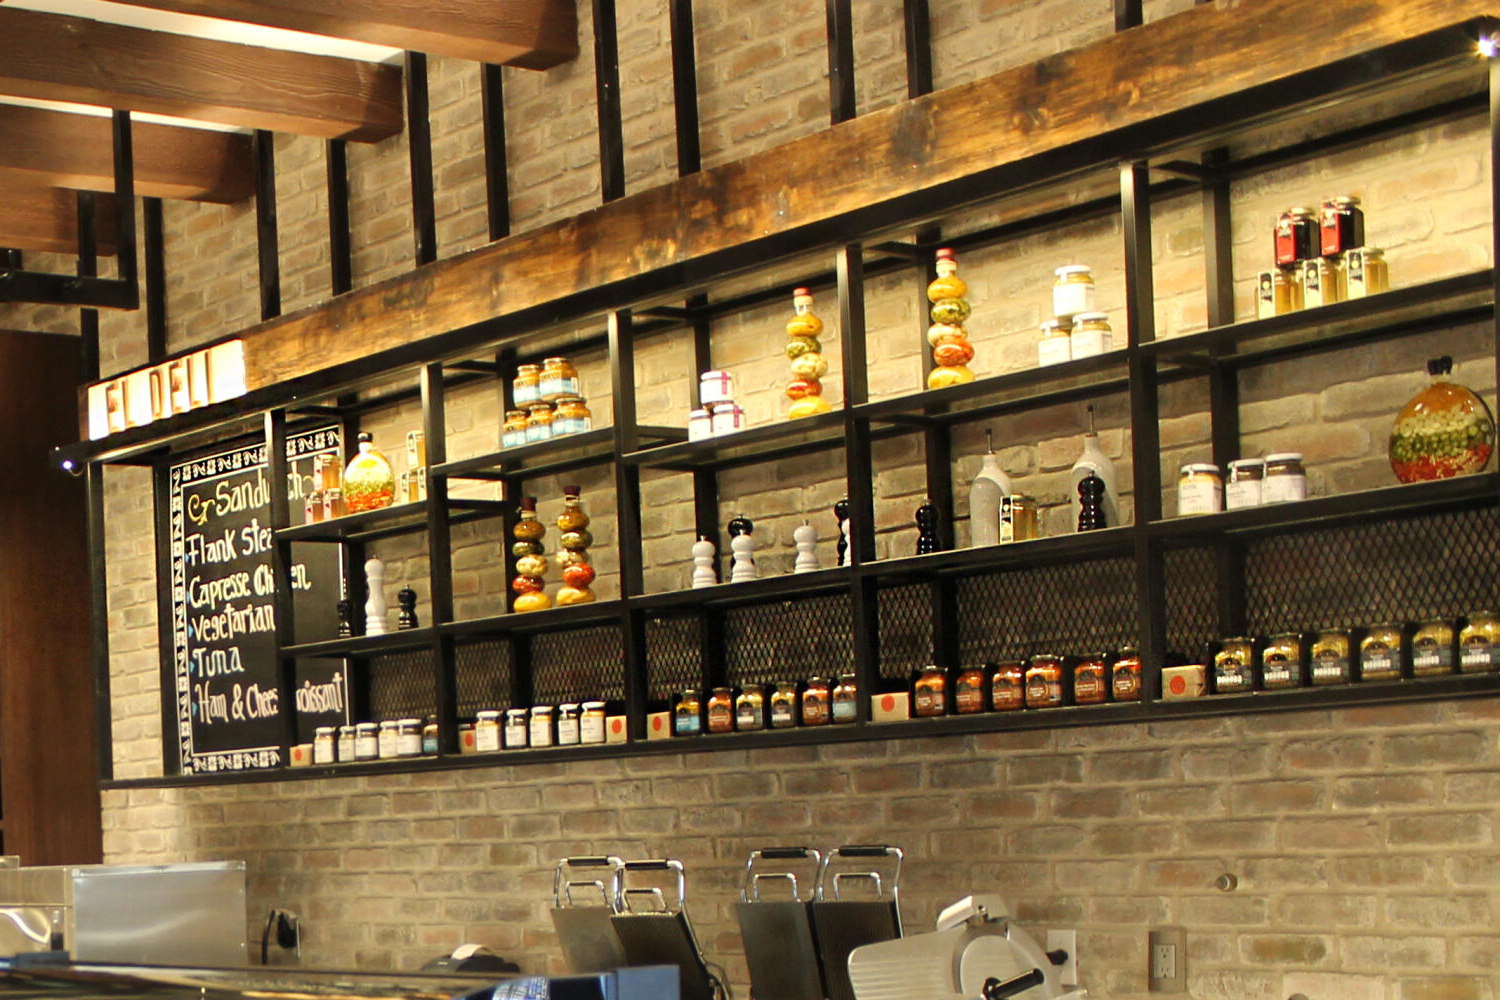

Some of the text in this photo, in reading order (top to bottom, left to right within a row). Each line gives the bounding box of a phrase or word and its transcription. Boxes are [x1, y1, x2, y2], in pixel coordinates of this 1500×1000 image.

[106, 347, 213, 434] EL DELI
[189, 571, 252, 611] Capresse
[191, 602, 276, 642] Vegetarian
[192, 646, 245, 678] Tuna
[194, 671, 344, 725] Ham & Chees roissant
